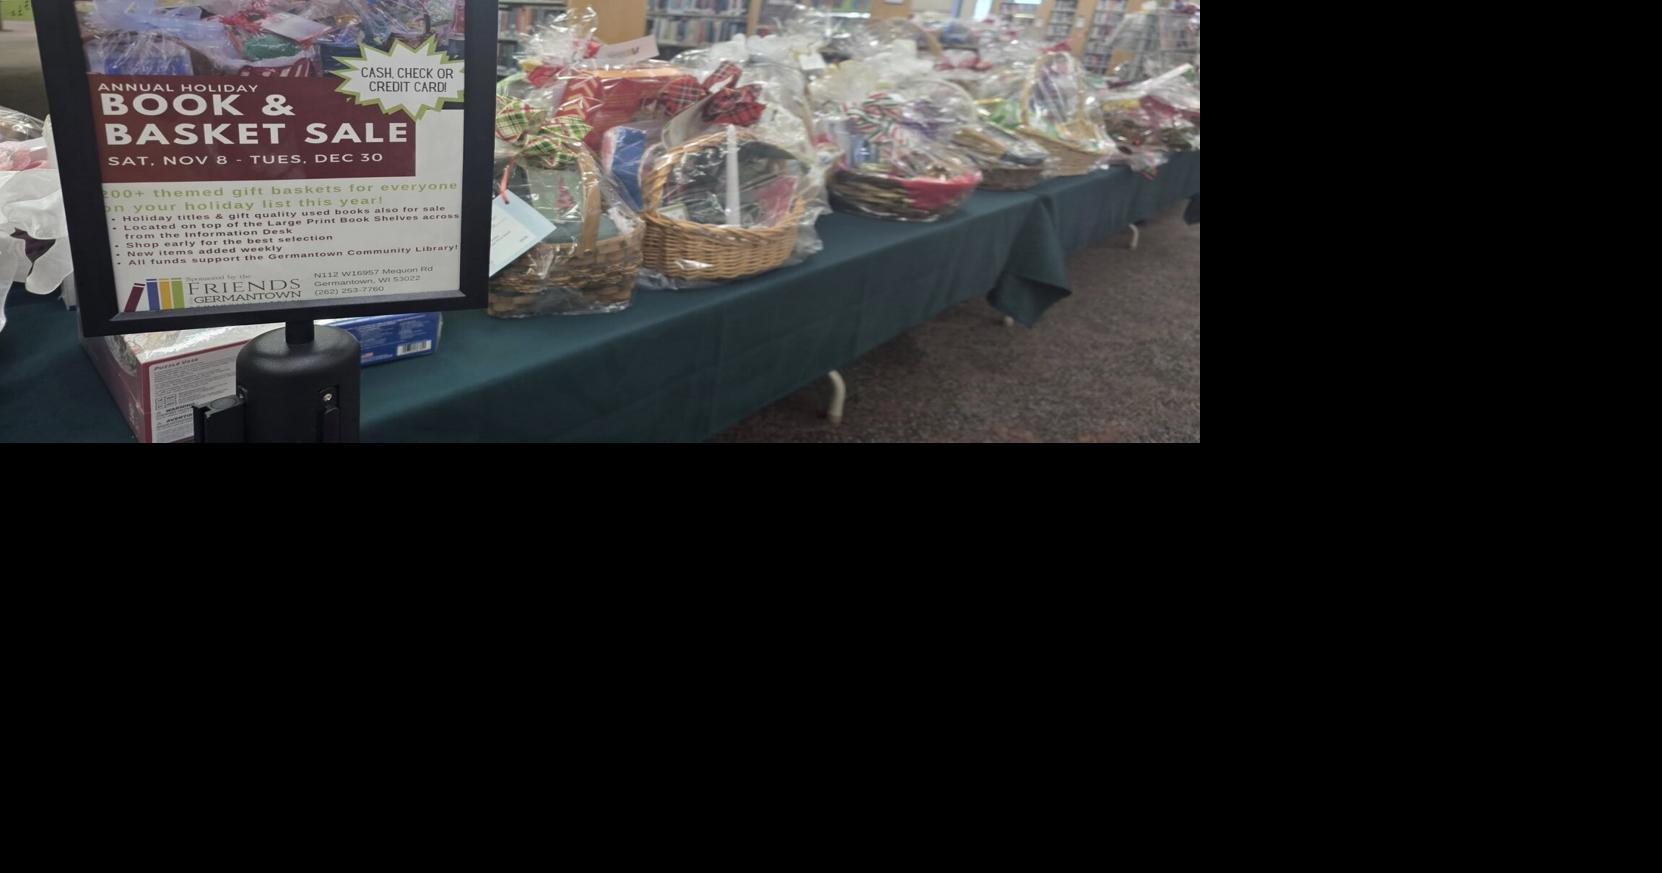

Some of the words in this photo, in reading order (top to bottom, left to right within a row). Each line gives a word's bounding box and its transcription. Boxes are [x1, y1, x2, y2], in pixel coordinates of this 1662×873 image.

[361, 67, 395, 80] CASH,
[397, 67, 434, 79] CHECK
[436, 67, 454, 79] OR
[97, 83, 174, 93] ANNUAL
[180, 84, 258, 93] HOLIDAY
[369, 81, 411, 92] CREDIT
[413, 81, 447, 93] CARD!
[99, 93, 243, 116] BOOK
[260, 93, 296, 116] &
[104, 122, 286, 145] BASKET
[304, 122, 408, 144] SALE
[163, 155, 208, 165] NOV
[216, 155, 228, 165] 8
[315, 153, 354, 163] DEC
[361, 153, 383, 163] 30
[153, 187, 224, 198] themed
[232, 186, 264, 198] gift
[271, 184, 342, 196] baskets
[349, 183, 373, 193] for
[380, 182, 457, 193] everyone
[133, 203, 176, 214] your
[184, 201, 254, 211] holiday
[262, 200, 291, 209] list
[299, 197, 332, 207] this
[340, 196, 383, 207] year!
[122, 213, 173, 223] Holiday
[177, 213, 210, 221] titles
[229, 212, 249, 221] gift
[254, 210, 297, 220] quality
[335, 207, 370, 215] books
[374, 206, 399, 214] also
[123, 223, 176, 231] Located
[202, 222, 222, 231] top
[244, 220, 263, 228] the
[267, 219, 302, 227] Large
[306, 217, 336, 225] Print
[340, 216, 370, 224] Book
[374, 214, 418, 222] Shelves
[422, 212, 460, 220] across
[125, 232, 155, 240] from
[160, 231, 180, 239] the
[185, 229, 258, 238] Information
[263, 228, 293, 236] Desk
[126, 242, 160, 250] Shop
[164, 240, 196, 249] early
[200, 239, 218, 247] for
[223, 238, 242, 246] the
[247, 237, 273, 245] best
[278, 234, 333, 243] selection
[127, 250, 154, 258] New
[159, 248, 194, 257] items
[198, 246, 236, 255] added
[241, 245, 282, 254] weekly
[151, 257, 187, 265] funds
[192, 255, 240, 265] support
[245, 253, 264, 262] the
[268, 250, 343, 260] Germantown
[347, 246, 412, 257] Community
[414, 243, 459, 254] Library!
[314, 271, 339, 279] N112
[382, 266, 419, 276] Mequon
[420, 265, 434, 273] Rd
[187, 278, 302, 295] FRIENDS
[314, 277, 376, 287] Germantown,
[393, 274, 421, 282] 53022
[193, 290, 302, 304] GERMANTOWN
[314, 288, 339, 297] (262)
